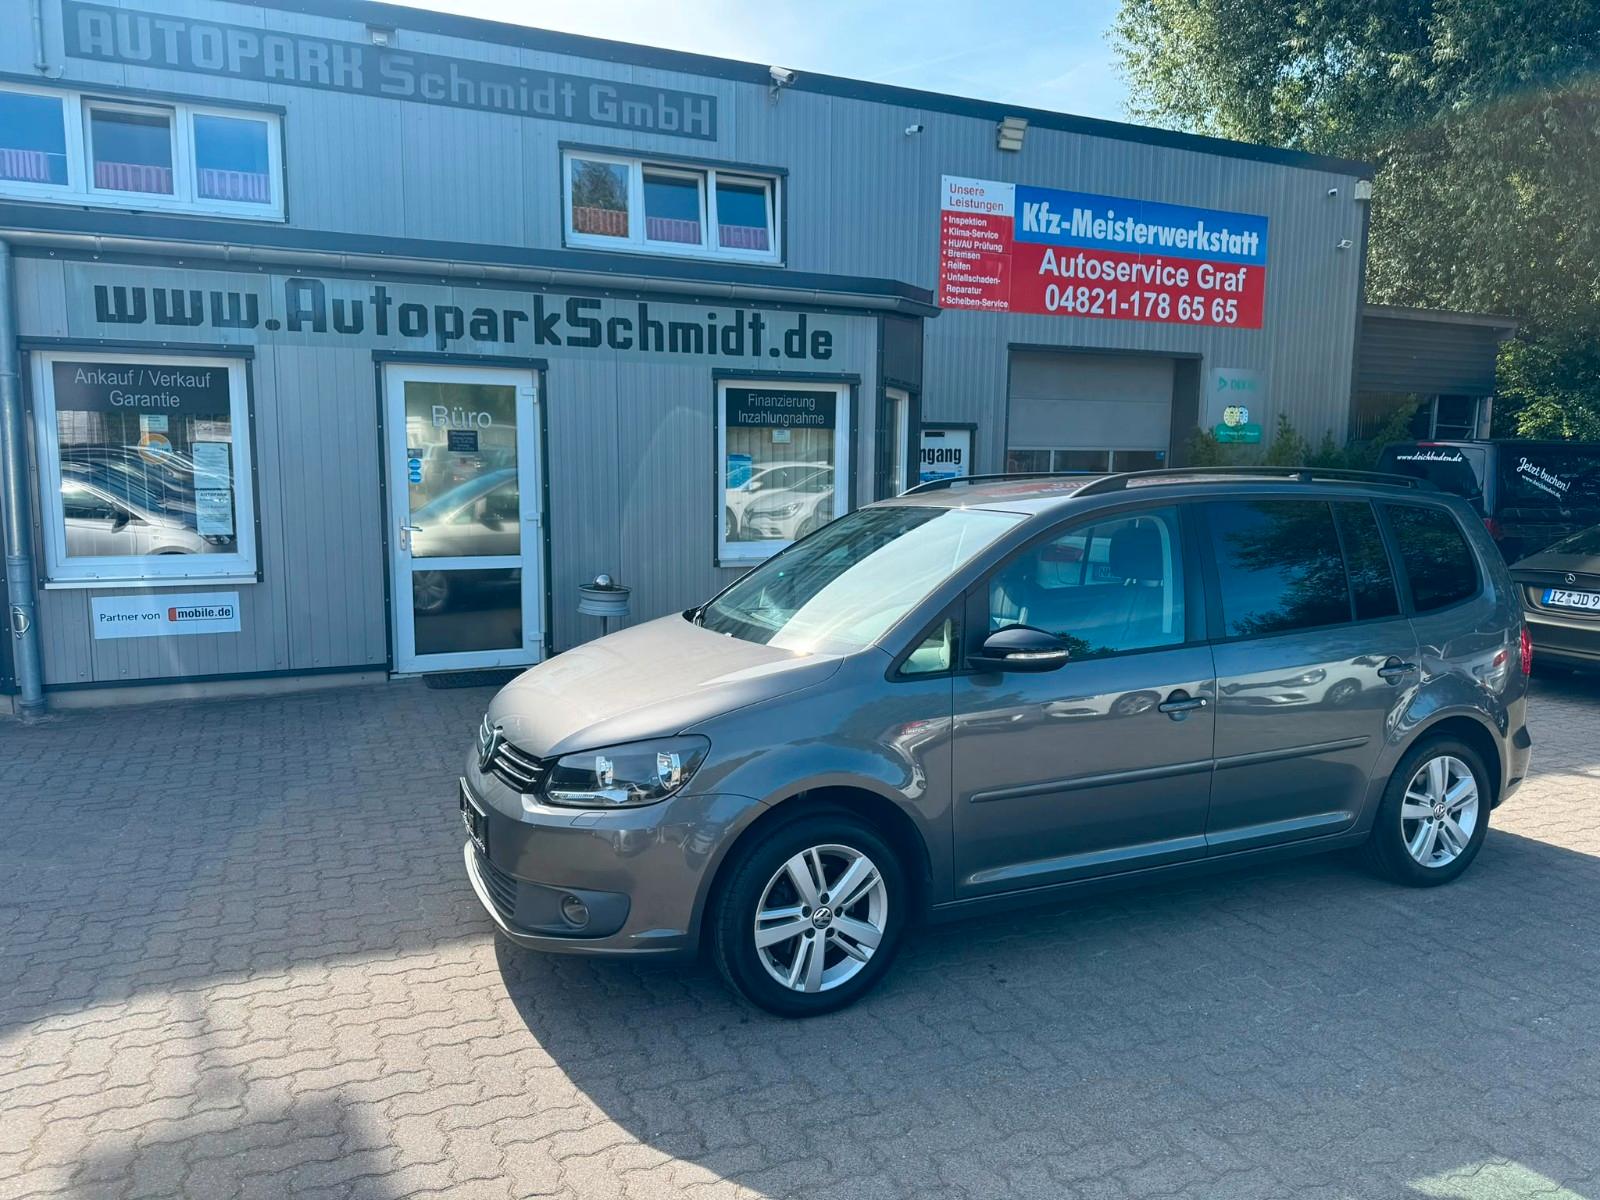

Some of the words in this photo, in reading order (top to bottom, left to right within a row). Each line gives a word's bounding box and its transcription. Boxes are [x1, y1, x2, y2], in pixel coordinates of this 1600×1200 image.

[77, 8, 364, 89] AUTOPARK
[380, 54, 576, 118] Schmidt
[589, 83, 710, 136] GmbH
[949, 183, 984, 196] Unsere
[949, 196, 1004, 212] Leistungen
[948, 216, 987, 227] Inspektion
[1022, 201, 1259, 256] Kfz-Meisterwerkstatt
[948, 227, 999, 240] Klima-Service
[948, 239, 973, 249] HU/AU
[974, 241, 1003, 253] Prüfung
[947, 249, 980, 260] Bremsen
[947, 261, 971, 271] Reifen
[1039, 249, 1189, 288] Autoservice
[1196, 263, 1247, 292] Graf
[947, 273, 1000, 285] Unfallschaden-
[946, 284, 982, 295] Reparatur
[946, 296, 1009, 308] Scheiben-Service
[1045, 284, 1170, 319] 04821-178
[1177, 295, 1205, 321] 65
[1211, 298, 1238, 323] 65
[94, 278, 833, 360] www.AutoparkSchmidt.de
[74, 368, 134, 386] Ankauf
[149, 371, 212, 388] Verkauf
[110, 390, 180, 408] Garantie
[748, 393, 816, 411] Finanzierung
[431, 405, 492, 428] Büro
[738, 410, 825, 427] Inzahlungnahme
[920, 447, 962, 465] ngang
[1516, 457, 1541, 477] Jetzt
[1540, 467, 1571, 492] buchen!
[1551, 590, 1566, 603] IZ
[1573, 593, 1589, 606] JD
[100, 612, 138, 622] Partner
[142, 612, 160, 621] von
[177, 607, 231, 619] mobile.de
